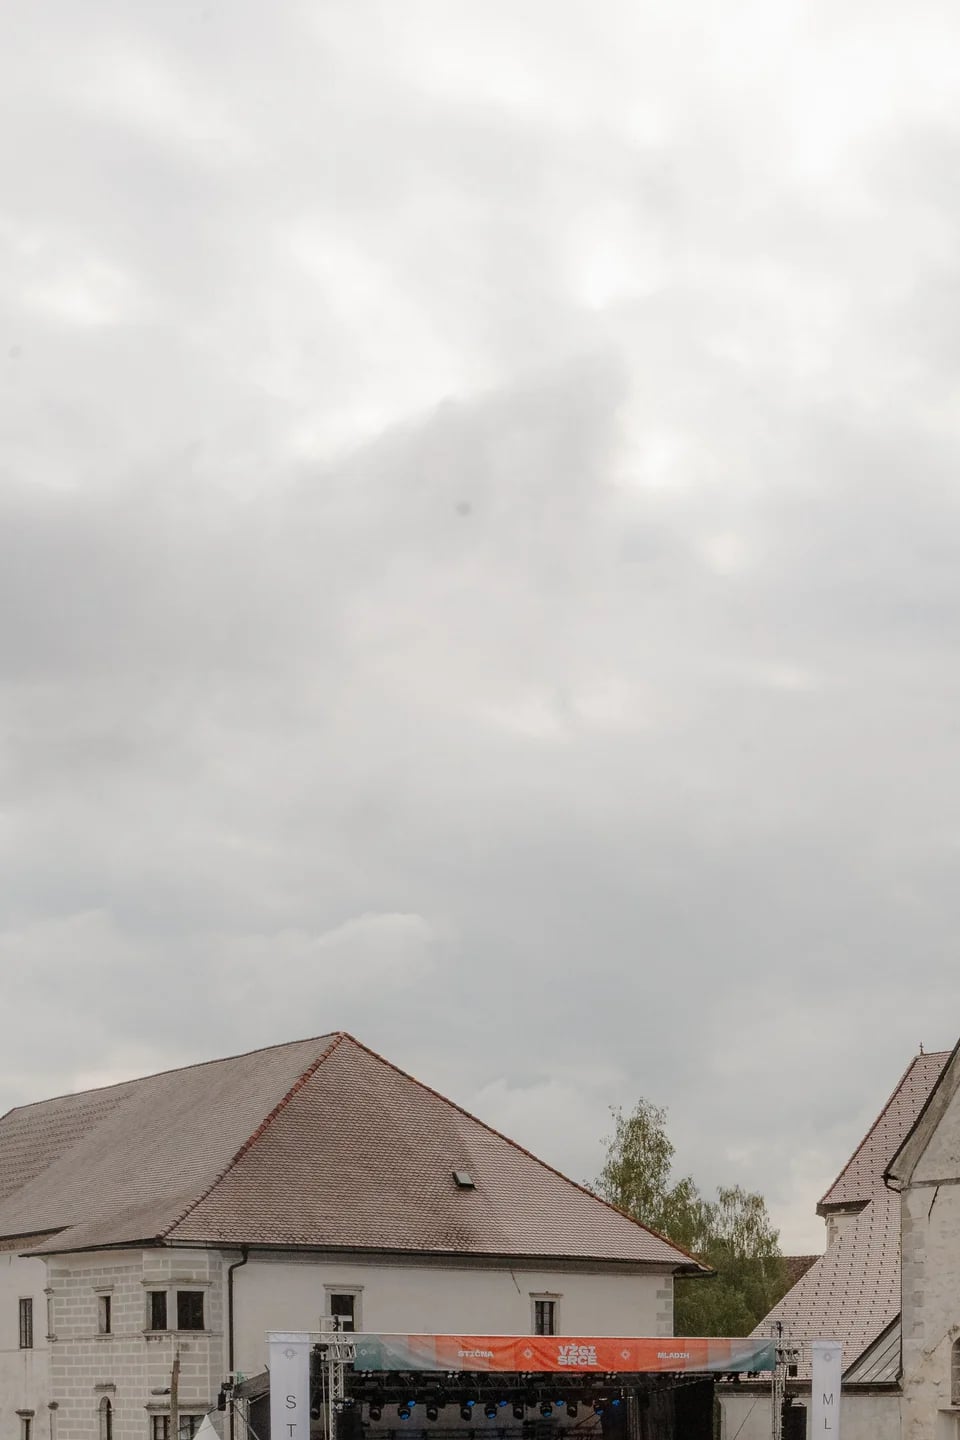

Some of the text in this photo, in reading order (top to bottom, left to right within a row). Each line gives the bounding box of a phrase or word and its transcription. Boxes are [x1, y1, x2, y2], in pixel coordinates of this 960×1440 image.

[457, 1349, 495, 1358] STIČNA
[558, 1343, 596, 1356] VŽGI
[557, 1355, 598, 1366] SRCE
[657, 1351, 690, 1360] MLADIH
